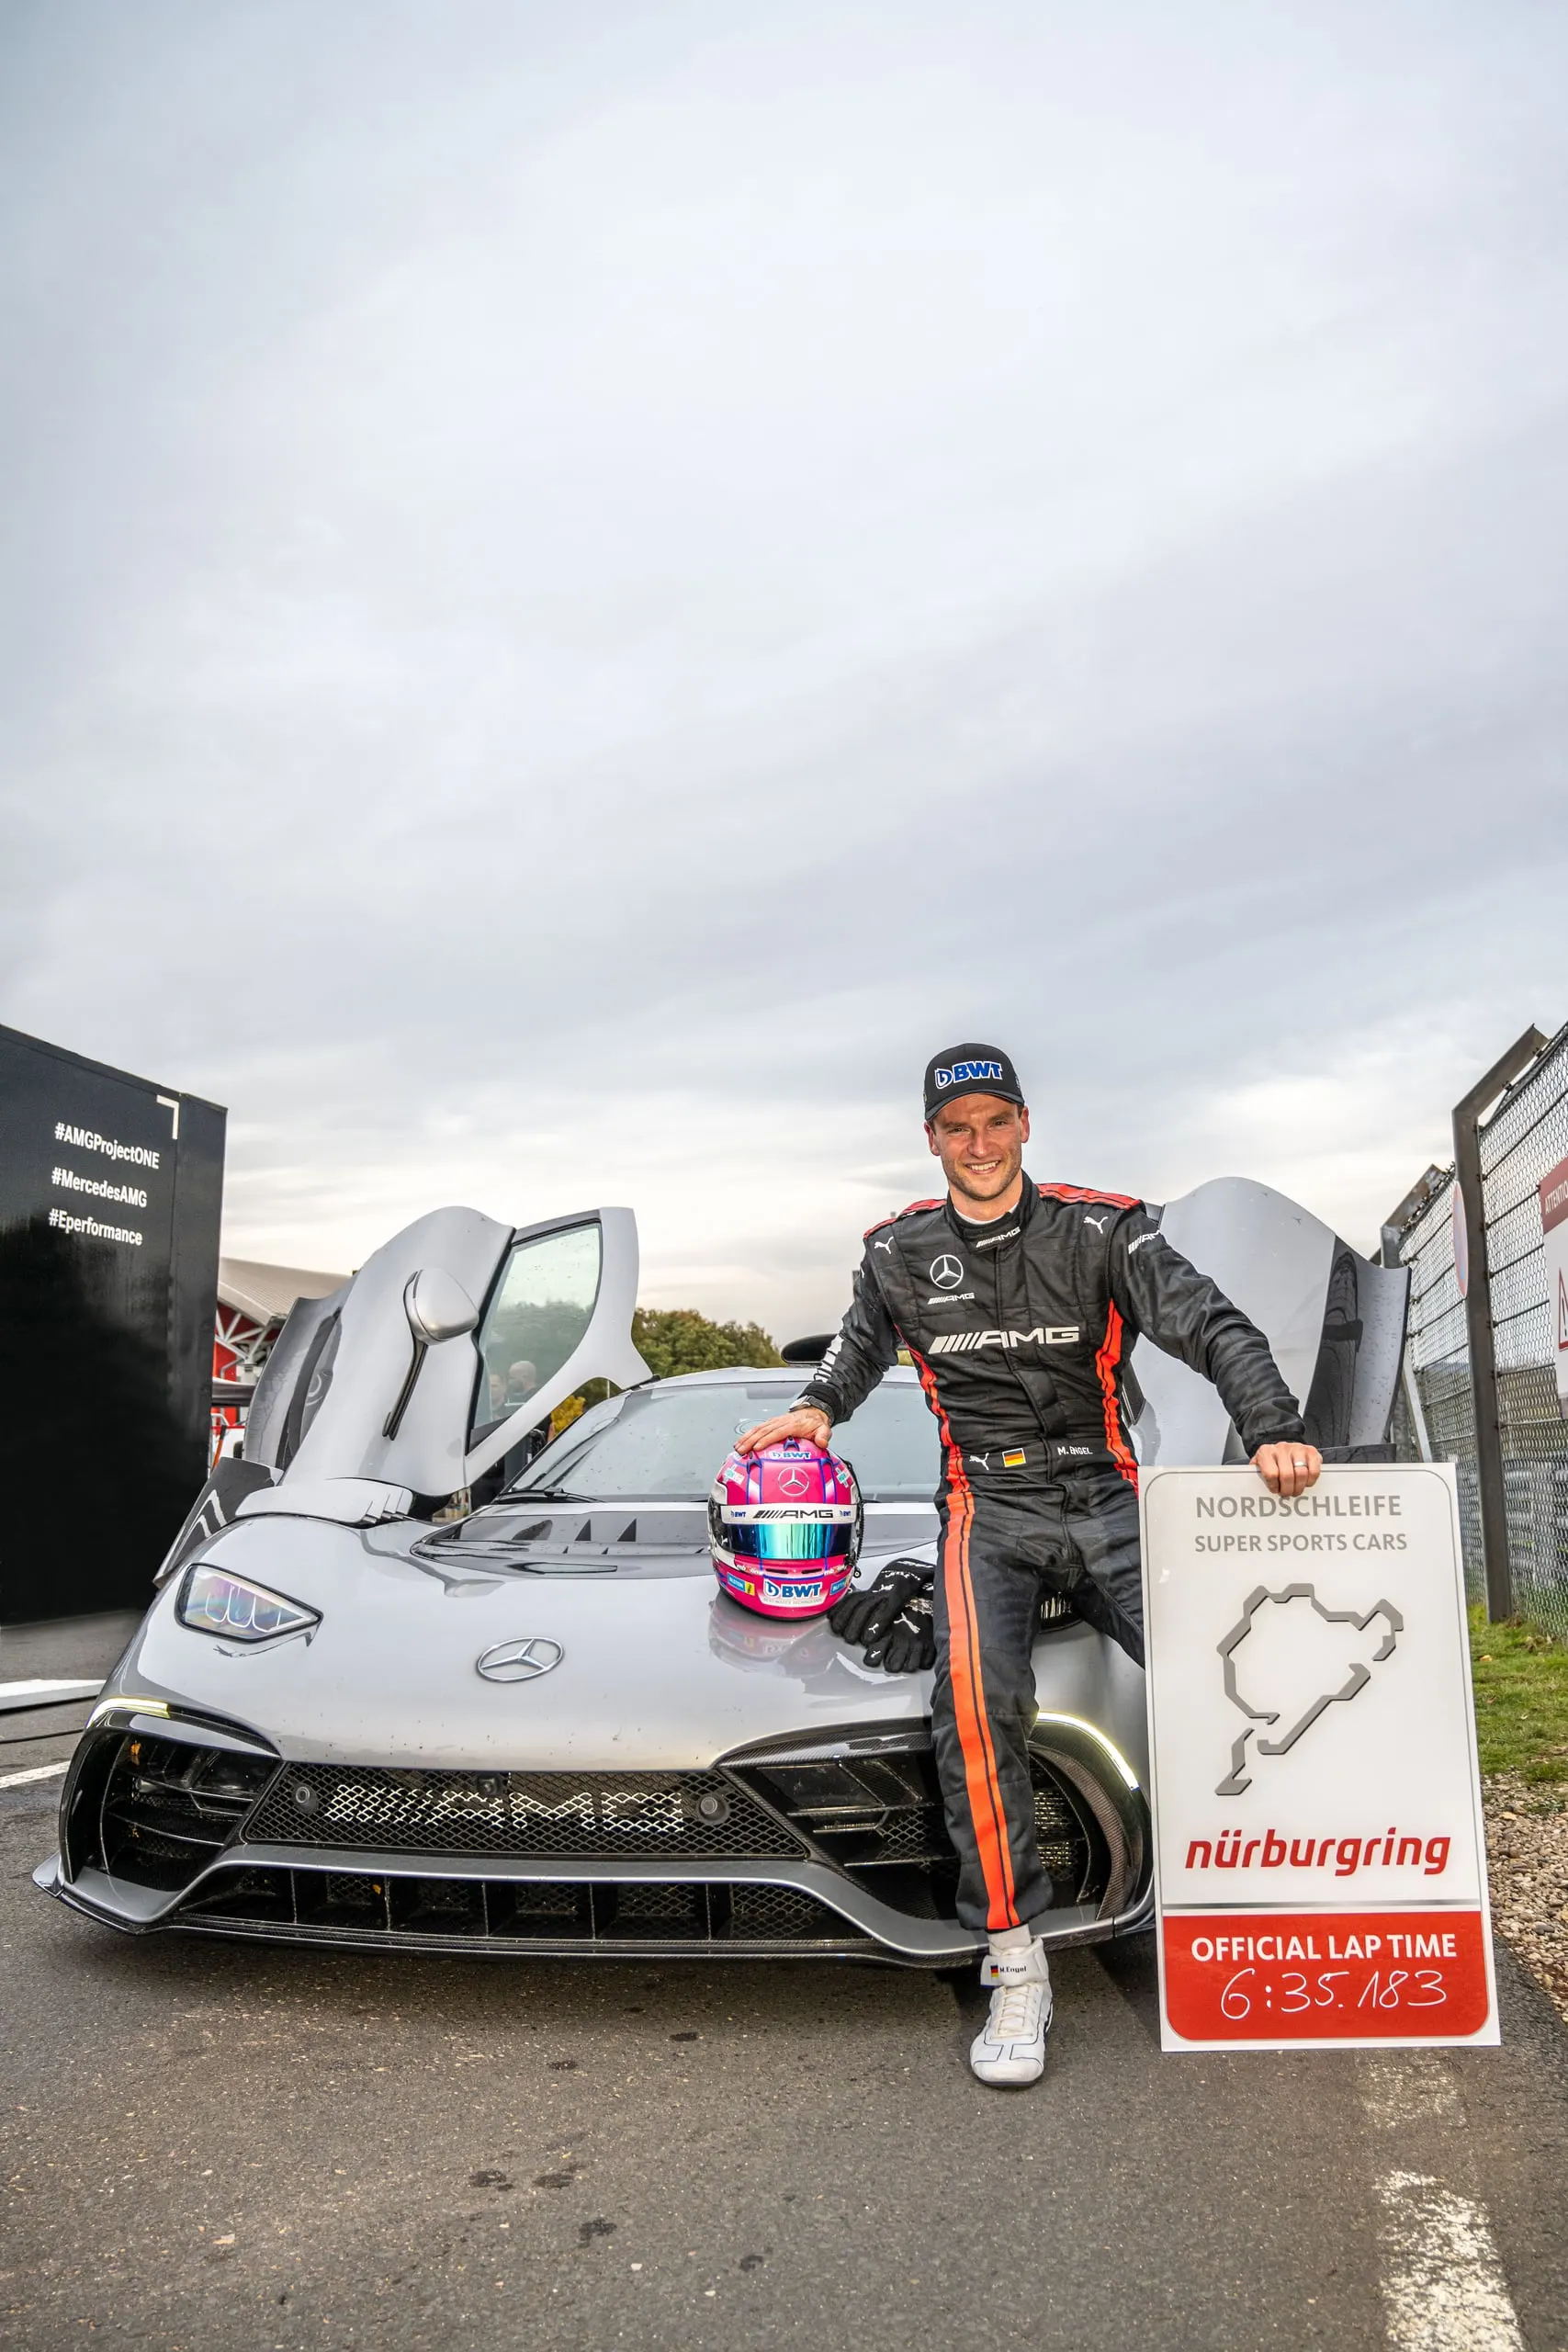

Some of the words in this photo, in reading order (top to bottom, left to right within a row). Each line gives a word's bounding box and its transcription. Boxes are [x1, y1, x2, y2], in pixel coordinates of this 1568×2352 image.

[952, 1061, 1003, 1083] BWT
[54, 1122, 161, 1170] #AMGProjectONE
[51, 1167, 148, 1208] #MercedesAMG
[49, 1208, 143, 1246] #Eperformance
[1070, 1446, 1093, 1455] ENGEL
[1196, 1495, 1402, 1518] NORDSCHLEIFE
[1195, 1535, 1262, 1552] SUPER
[1268, 1533, 1348, 1552] SPORTS
[1353, 1533, 1407, 1551] CARS
[782, 1583, 821, 1598] BWT
[1185, 1826, 1450, 1876] nürburgring
[1191, 1936, 1322, 1962] OFFICIAL
[1328, 1934, 1382, 1960] LAP
[1386, 1933, 1457, 1958] TIME
